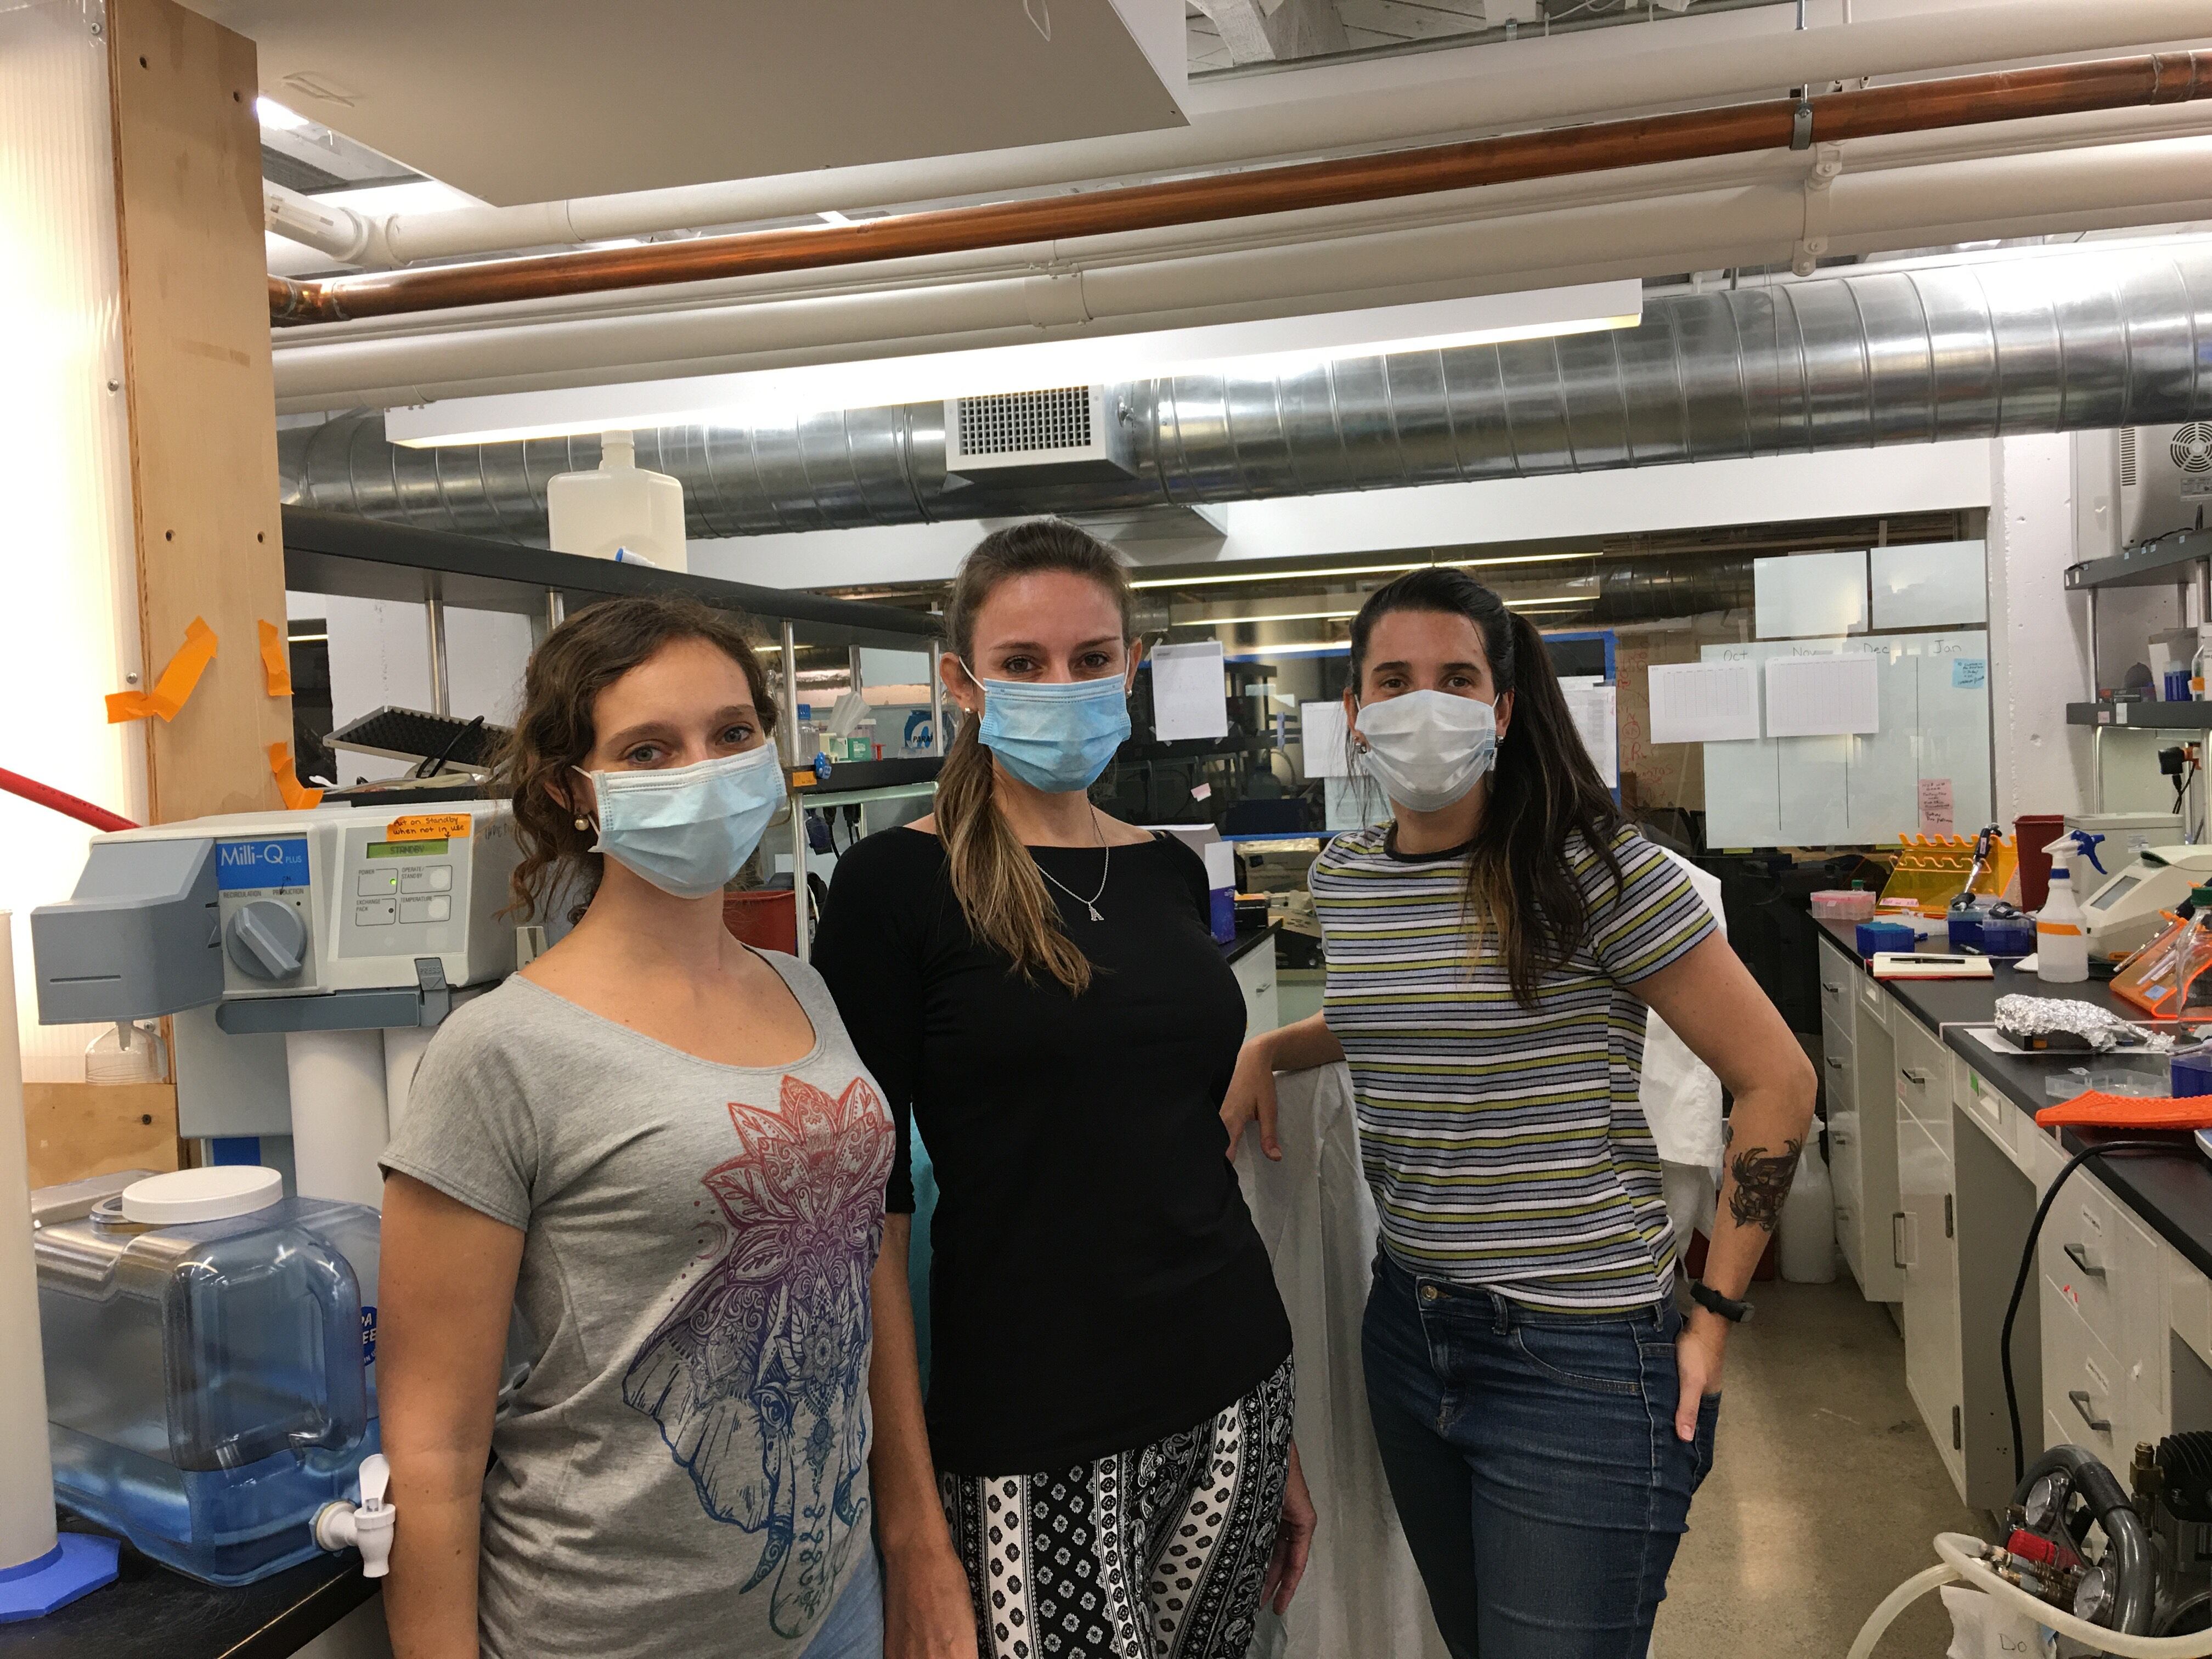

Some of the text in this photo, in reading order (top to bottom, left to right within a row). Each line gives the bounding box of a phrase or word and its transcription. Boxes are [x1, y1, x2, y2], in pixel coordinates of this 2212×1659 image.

[1723, 640, 1961, 661] Oct Nov Dec Jan
[221, 844, 302, 866] Milli-Q PLUS
[390, 845, 425, 855] STANDBY
[223, 890, 262, 899] RECIRCULATION
[1998, 1633, 2027, 1652] Do
